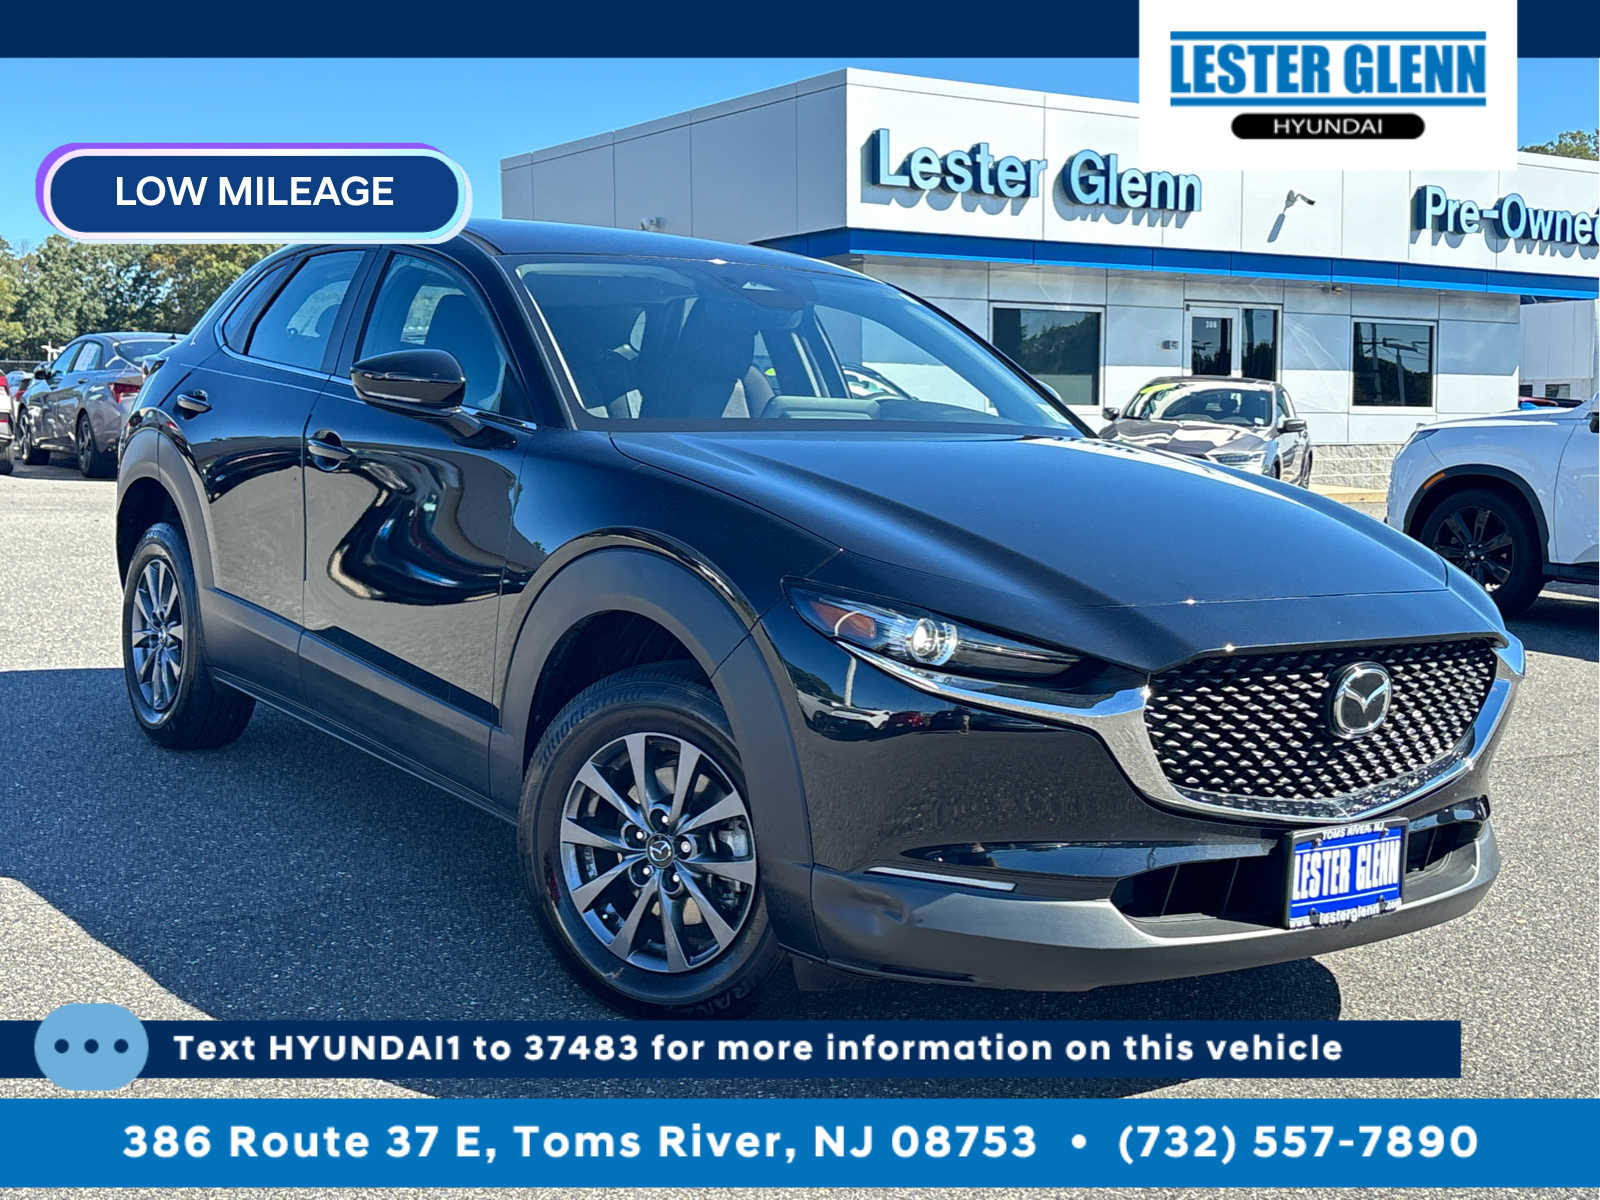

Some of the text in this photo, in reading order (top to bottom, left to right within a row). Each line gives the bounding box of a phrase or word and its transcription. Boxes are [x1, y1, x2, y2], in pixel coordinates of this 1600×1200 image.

[873, 128, 1202, 212] Lester Glenn
[1422, 184, 1599, 246] Pre-Owne
[1322, 828, 1346, 841] TOMS
[1292, 839, 1401, 901] LESTER GLENN
